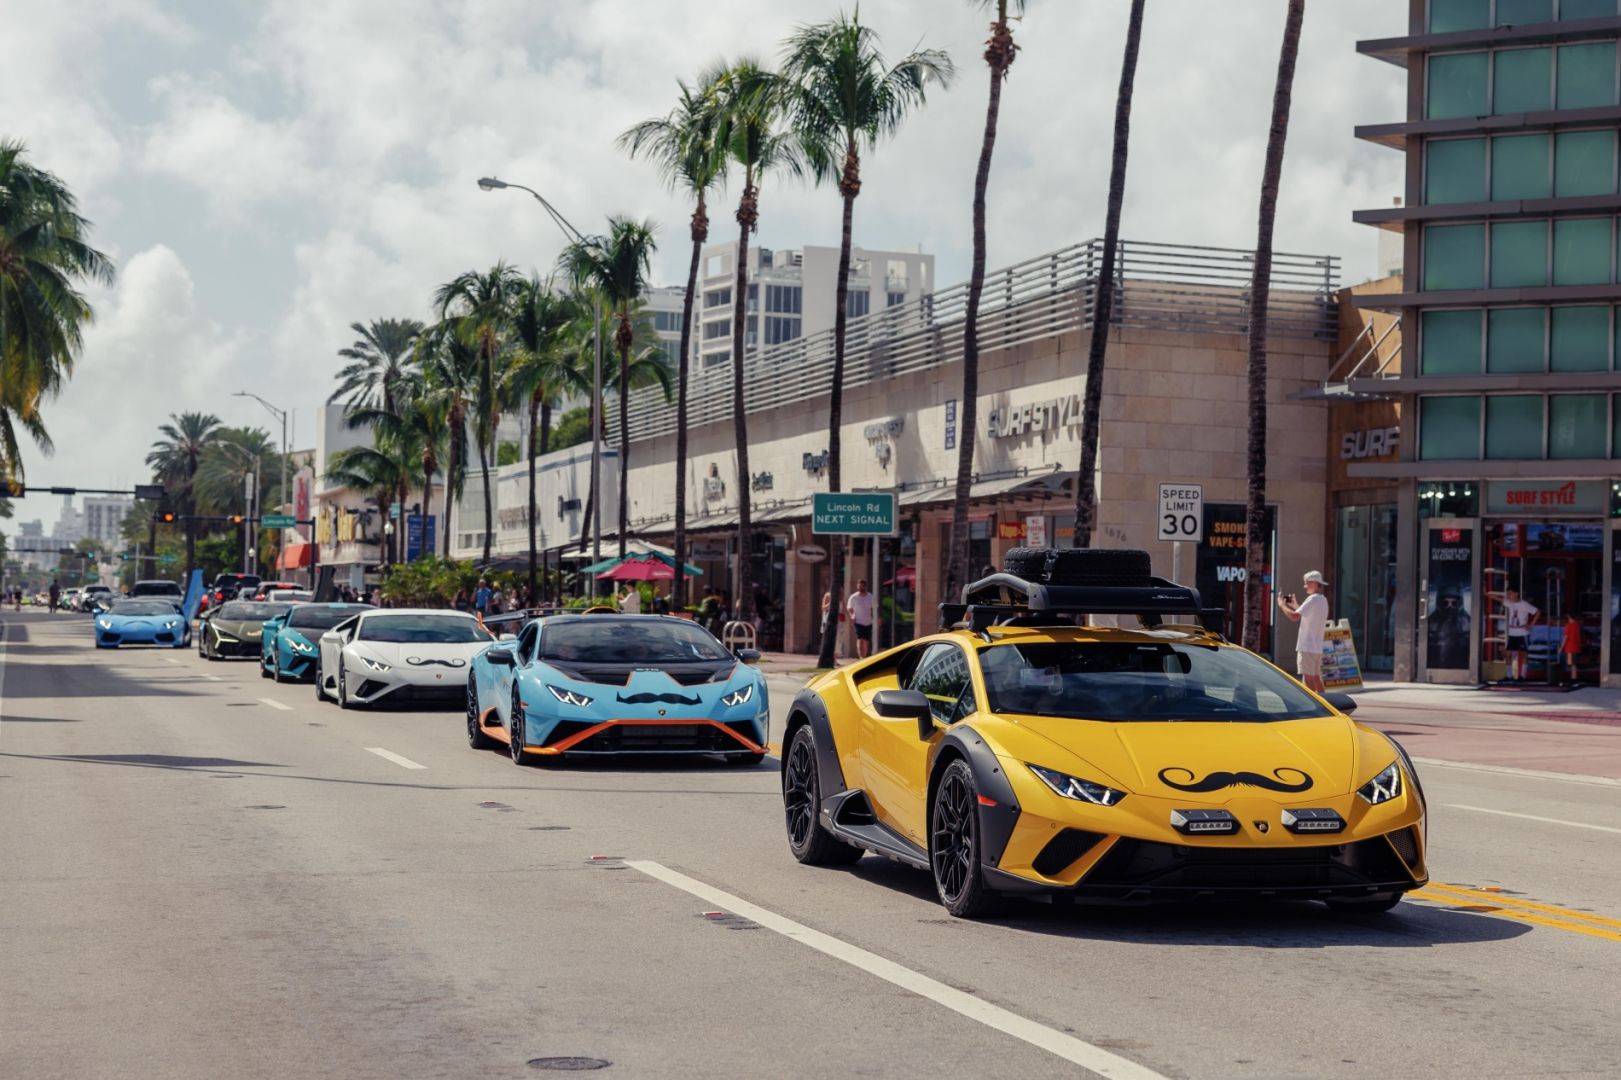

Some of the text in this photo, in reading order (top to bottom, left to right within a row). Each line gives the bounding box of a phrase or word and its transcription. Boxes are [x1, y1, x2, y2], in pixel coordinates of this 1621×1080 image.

[1162, 489, 1199, 500] SPEED
[1506, 481, 1576, 505] SURF STYLE
[827, 503, 880, 513] Lincoln Rd
[1166, 501, 1195, 512] LIMIT
[816, 515, 889, 525] NEXT SIGNAL
[1162, 514, 1197, 535] 30
[1216, 566, 1246, 582] VAPO
